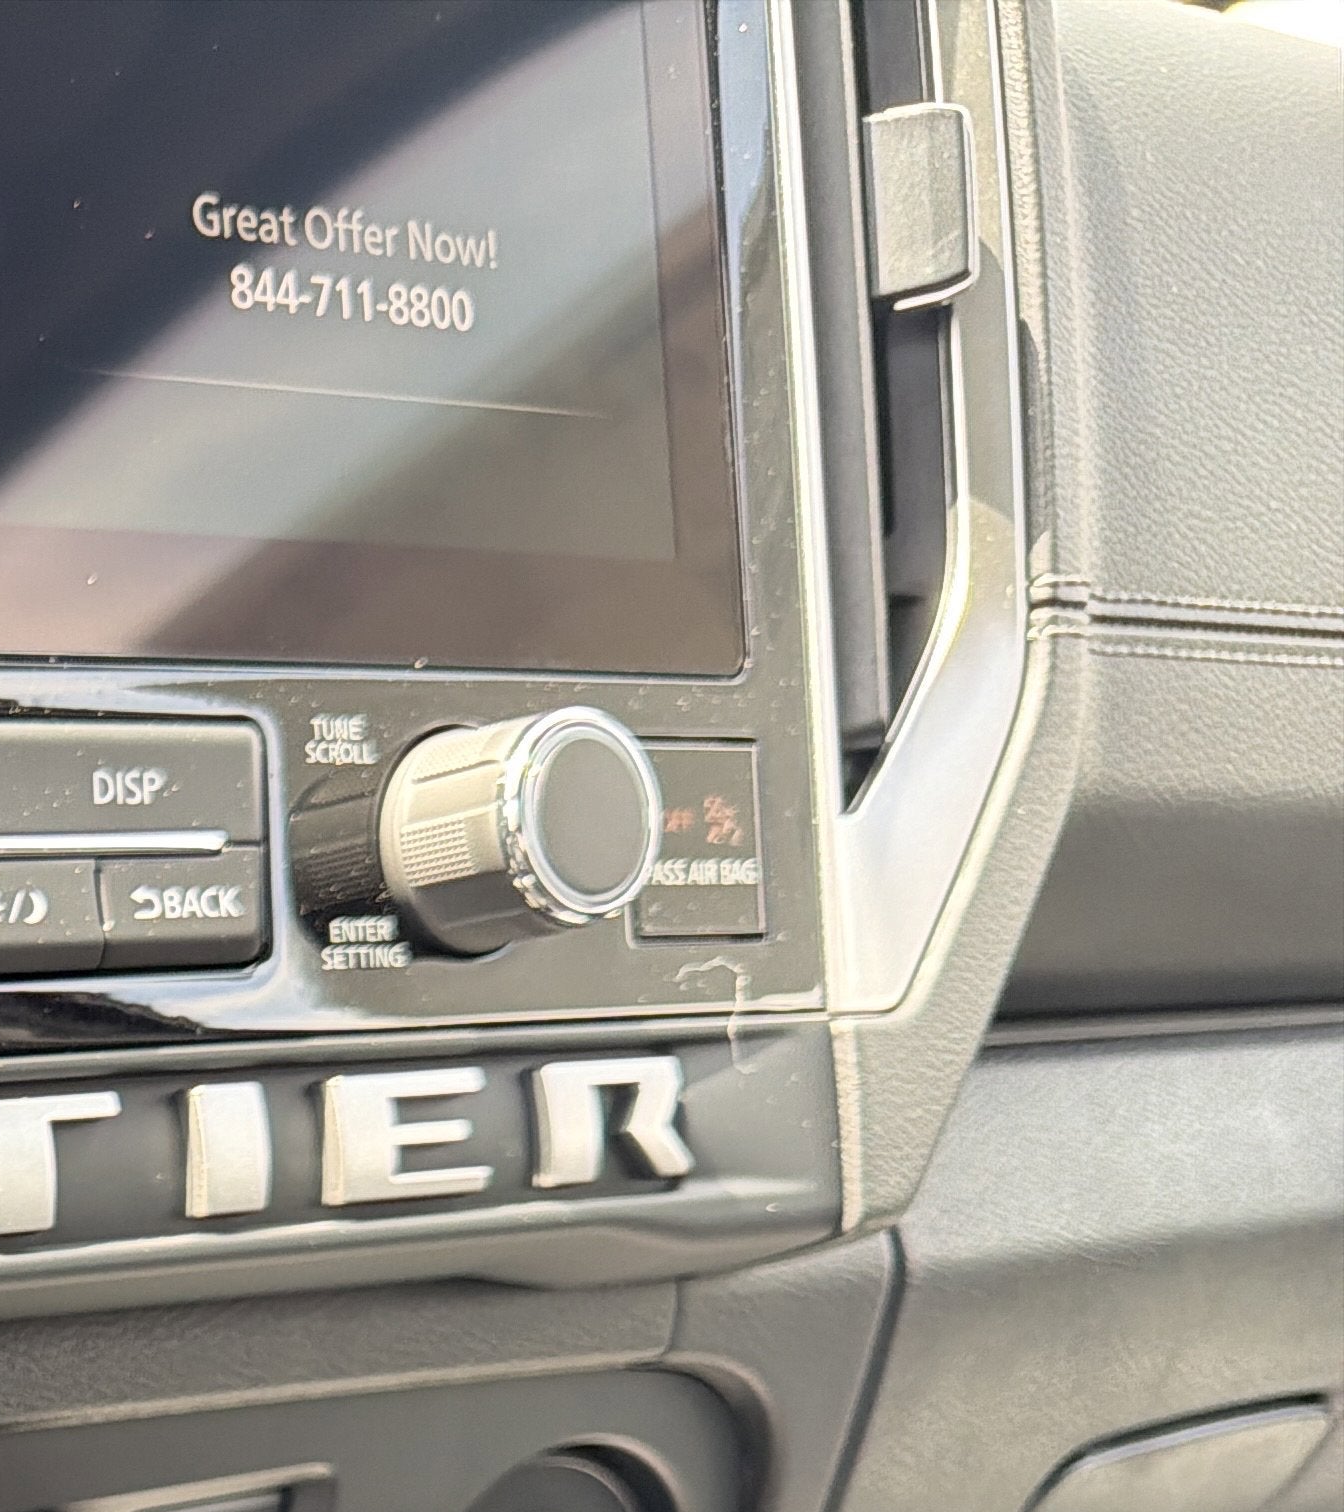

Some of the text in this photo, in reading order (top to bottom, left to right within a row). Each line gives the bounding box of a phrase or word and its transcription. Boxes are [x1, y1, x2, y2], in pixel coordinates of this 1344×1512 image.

[192, 191, 499, 270] Great Offer Now!
[230, 261, 474, 334] 844-711-8800
[309, 715, 367, 741] TUNE
[305, 742, 378, 766] SCROLL
[92, 767, 167, 805] DISP
[687, 860, 720, 885] AIR
[720, 859, 759, 884] BAG
[163, 886, 244, 919] BACK
[328, 915, 398, 943] ENTER
[321, 943, 410, 971] SETTING
